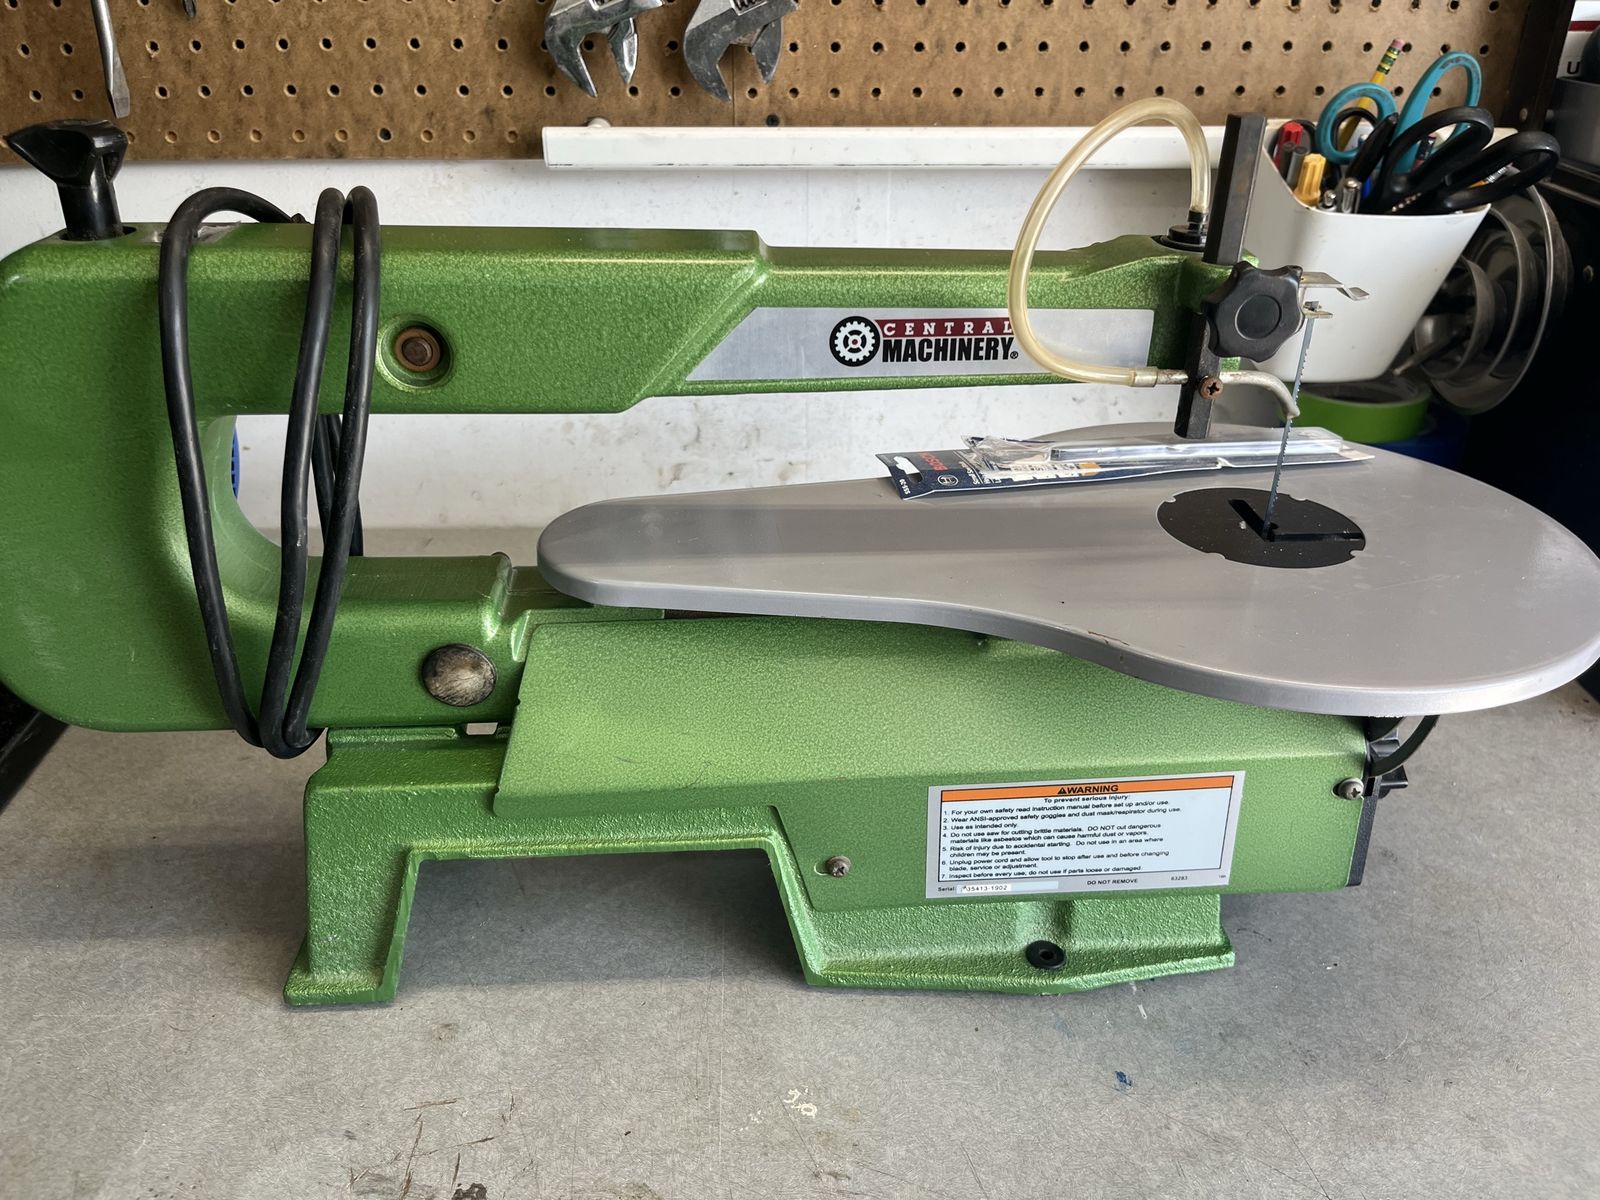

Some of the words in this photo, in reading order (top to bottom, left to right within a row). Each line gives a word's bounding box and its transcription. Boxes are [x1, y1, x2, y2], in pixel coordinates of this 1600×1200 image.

[884, 321, 1014, 336] CENTRAL
[1066, 785, 1119, 794] WARNING
[969, 814, 1018, 822] ANSI-approved
